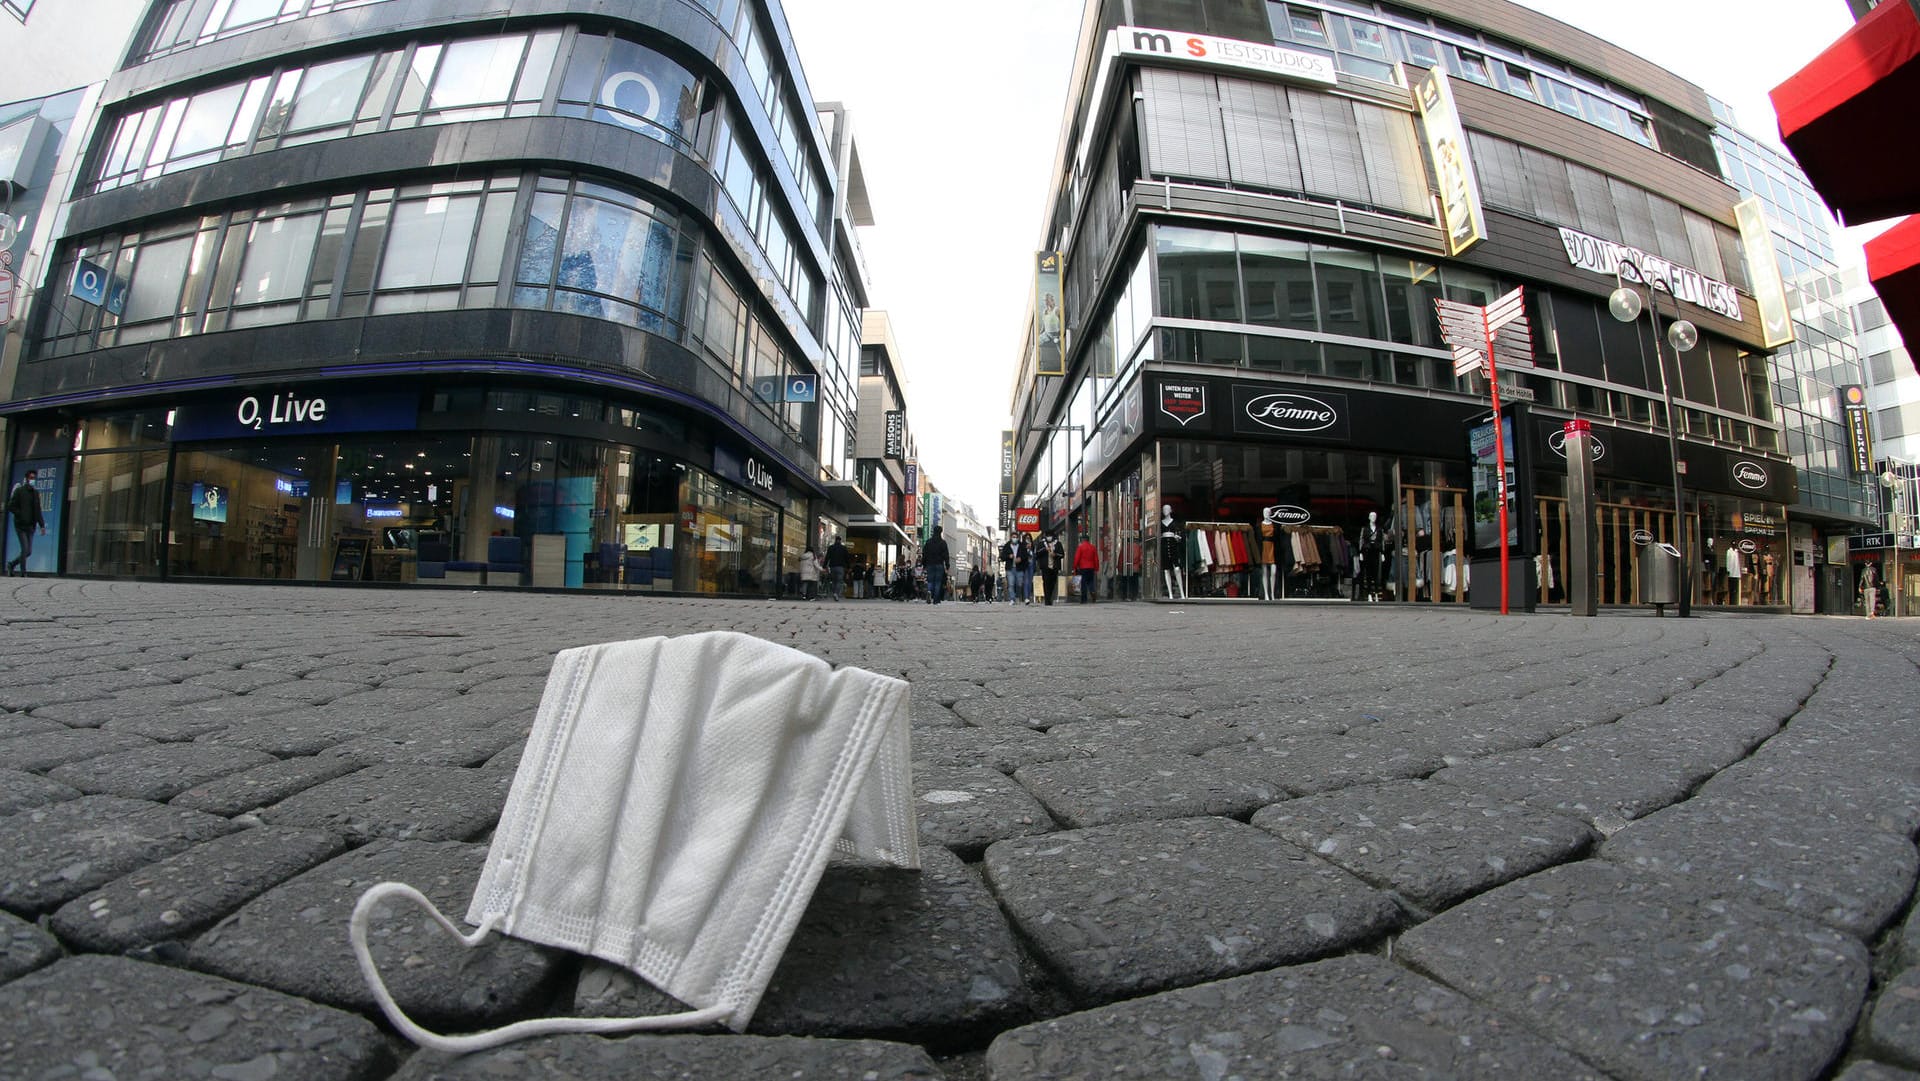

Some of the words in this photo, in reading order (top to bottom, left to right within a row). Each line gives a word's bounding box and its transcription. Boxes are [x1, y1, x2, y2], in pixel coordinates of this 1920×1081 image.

[1216, 41, 1323, 72] TESTSTUDIOS
[270, 392, 326, 423] Live
[887, 414, 896, 455] MAISONS
[1853, 410, 1868, 471] SPIELHALLE
[757, 463, 773, 491] Live
[1018, 514, 1038, 525] LEGO
[1866, 537, 1881, 546] RTK
